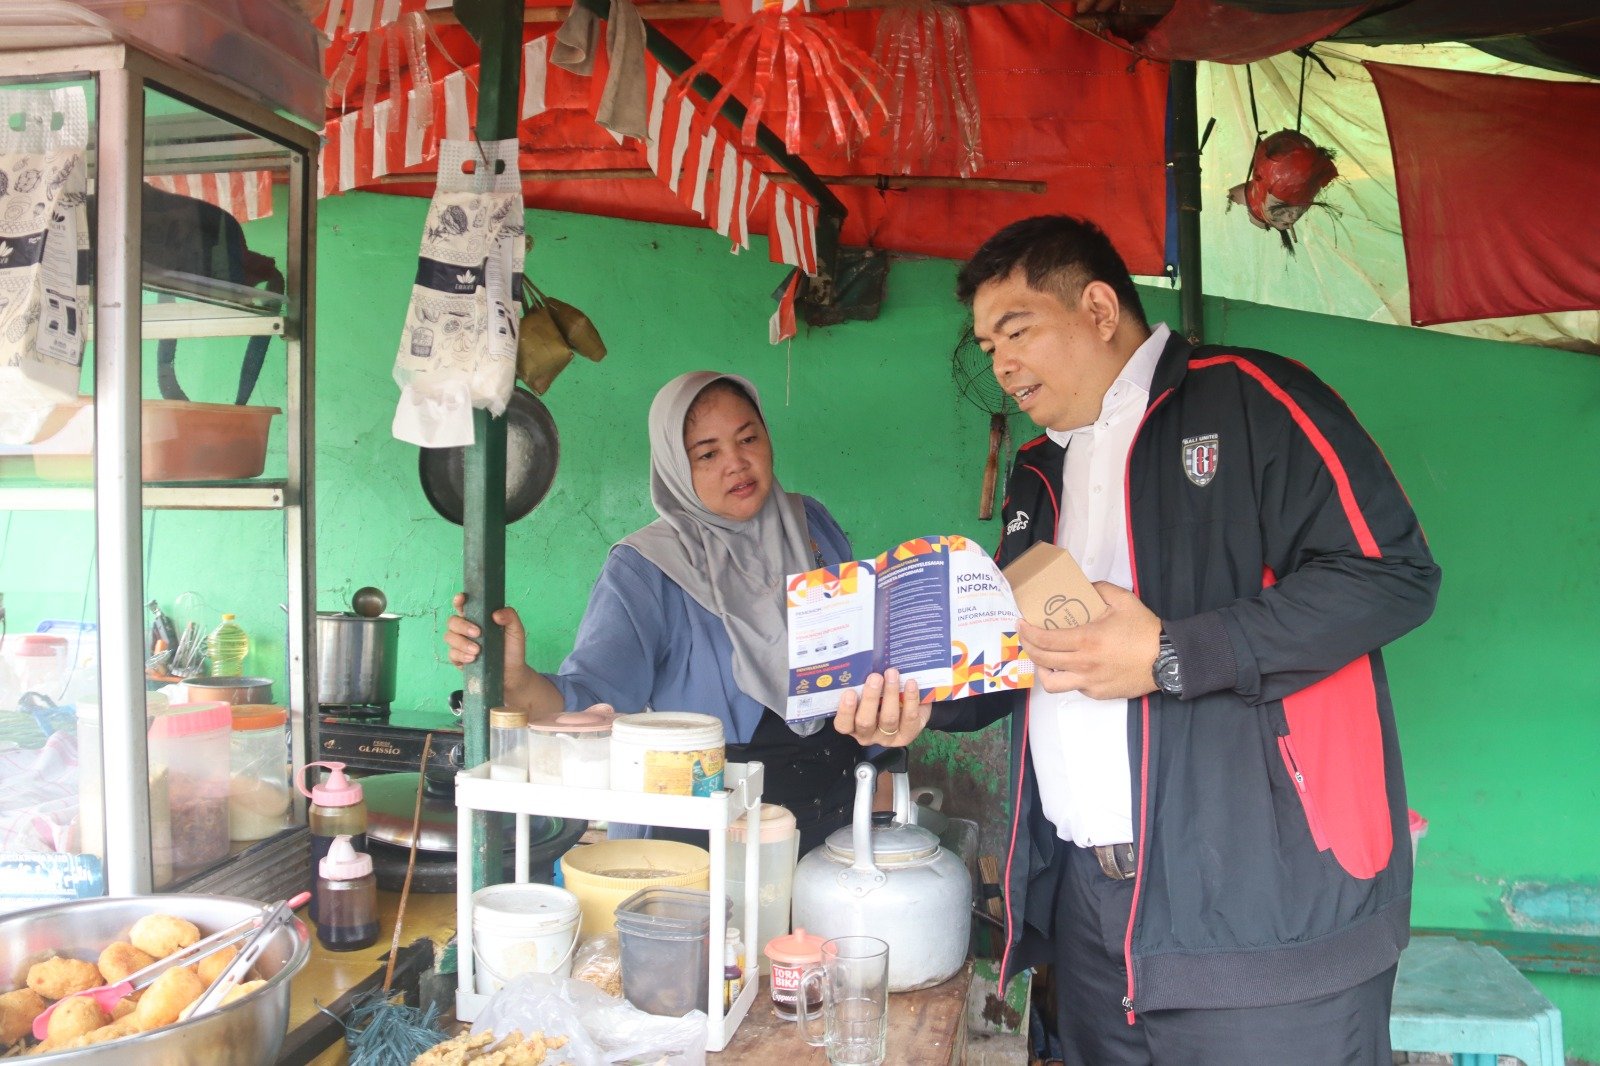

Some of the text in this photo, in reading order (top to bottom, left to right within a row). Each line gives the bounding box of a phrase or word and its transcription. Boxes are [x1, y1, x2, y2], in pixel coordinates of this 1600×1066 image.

[1199, 433, 1219, 442] UNITED
[957, 583, 1001, 594] INFORM
[957, 606, 977, 614] BUKA
[957, 610, 997, 621] INFORMASI
[775, 968, 800, 980] TORA
[775, 977, 800, 988] BIKA
